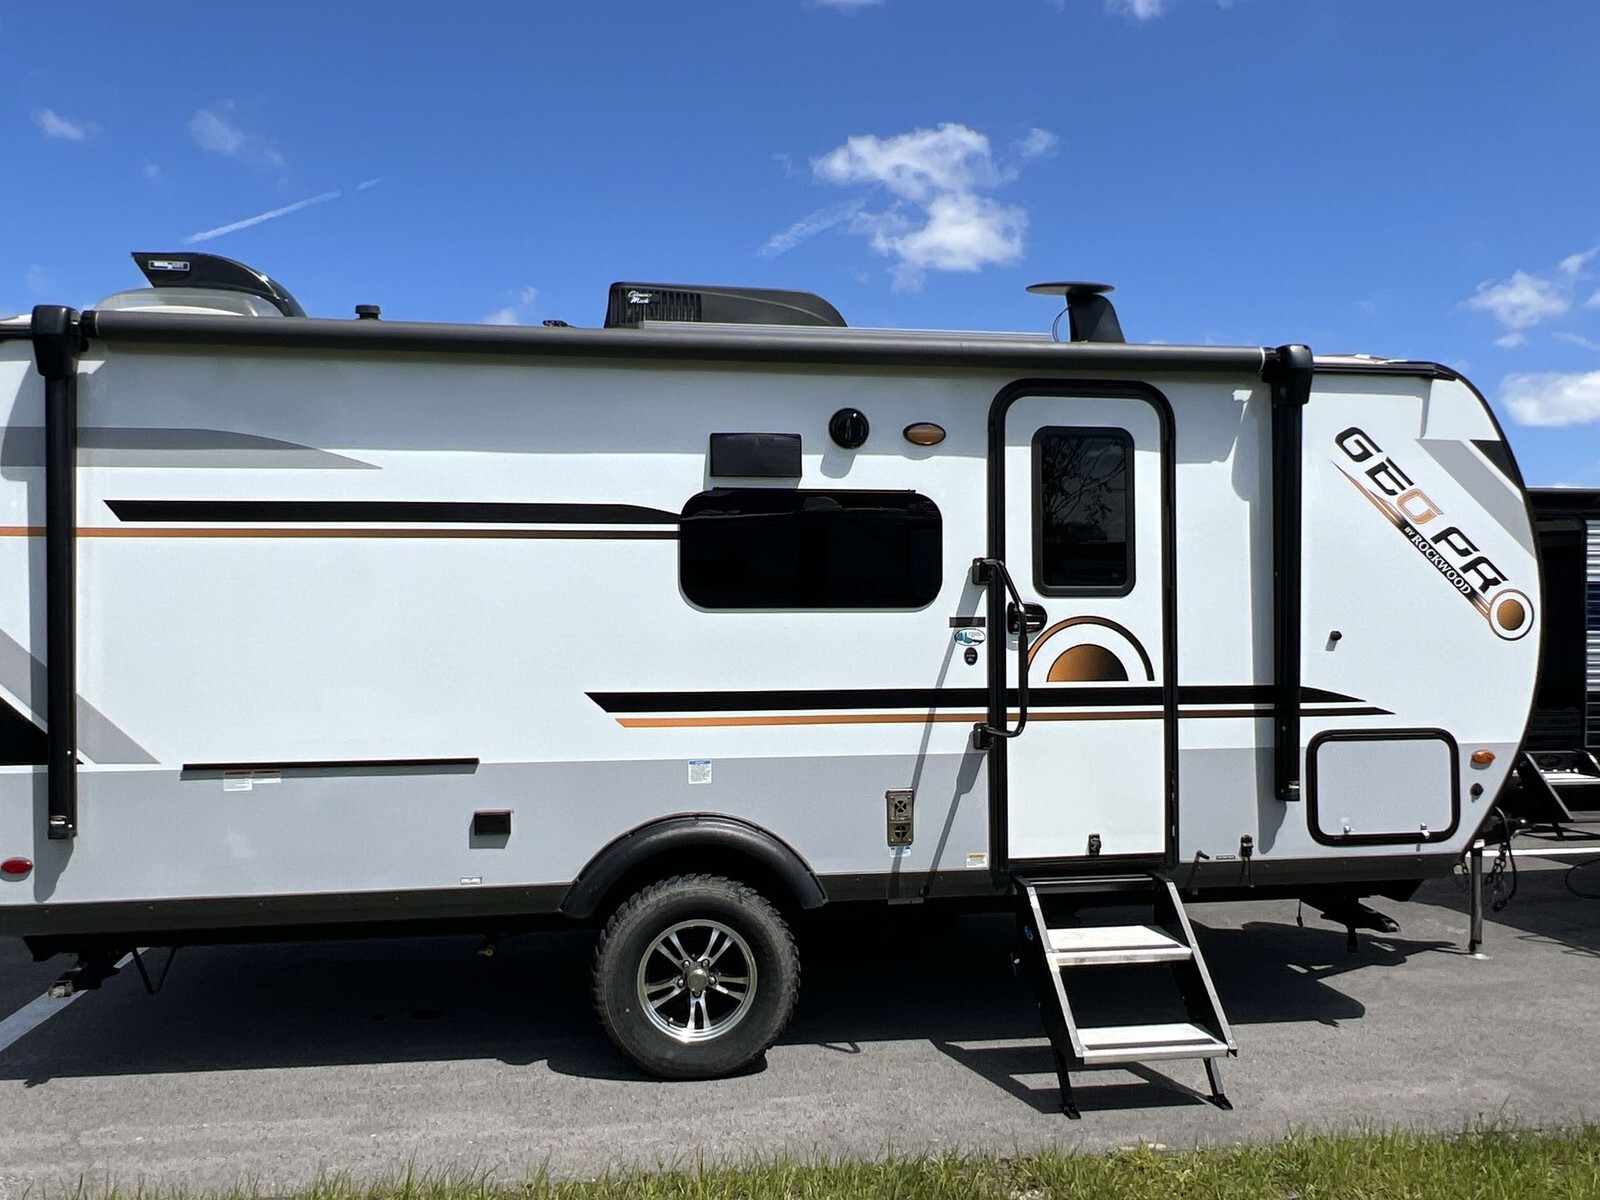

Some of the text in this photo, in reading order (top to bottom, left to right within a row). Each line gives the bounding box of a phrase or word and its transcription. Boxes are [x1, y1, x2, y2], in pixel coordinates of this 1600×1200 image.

[1335, 427, 1445, 525] GEO
[1404, 526, 1472, 595] BY ROCKWOOD
